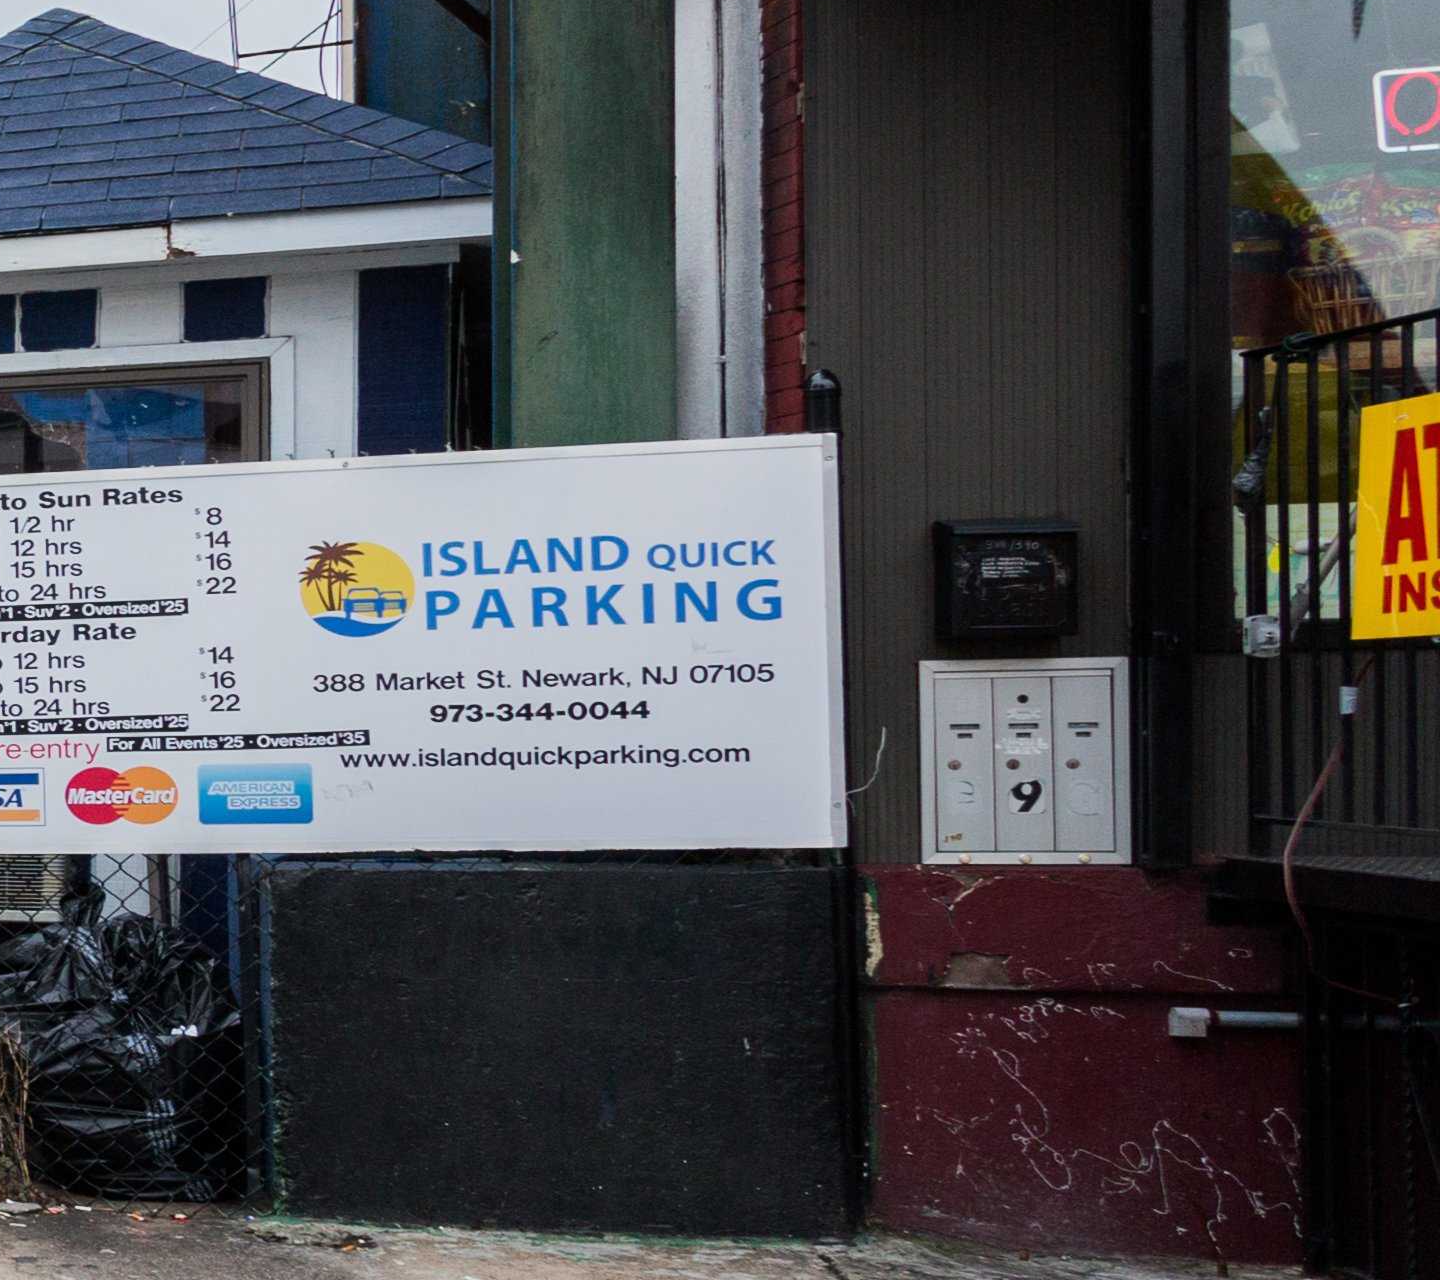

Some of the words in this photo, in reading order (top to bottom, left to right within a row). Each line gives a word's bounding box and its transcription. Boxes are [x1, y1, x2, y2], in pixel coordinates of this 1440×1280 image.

[0, 494, 26, 511] to
[39, 491, 91, 509] Sun
[103, 487, 183, 506] Rates
[10, 516, 41, 534] 1/2
[52, 515, 75, 532] hr
[10, 540, 35, 557] 12
[45, 538, 82, 555] hrs
[422, 536, 630, 577] ISLAND
[646, 539, 776, 572] QUICK
[10, 562, 35, 579] 15
[45, 560, 83, 577] hrs
[31, 583, 59, 600] 24
[69, 582, 106, 600] hrs
[425, 579, 782, 630] PARKING
[73, 622, 137, 641] Rate
[13, 652, 38, 671] 12
[47, 651, 85, 669] hrs
[14, 676, 39, 695] 15
[48, 675, 86, 694] hrs
[314, 674, 364, 693] 388
[376, 670, 465, 691] Market
[477, 669, 511, 689] St.
[522, 666, 631, 689] Newark,
[641, 665, 678, 686] NJ
[690, 663, 774, 684] 07105
[0, 699, 23, 718] to
[34, 699, 63, 717] 24
[72, 698, 110, 716] hrs
[430, 701, 650, 723] 973-344-0044
[108, 738, 134, 751] For
[141, 737, 160, 750] All
[339, 746, 751, 769] www.islandquickparking.com
[67, 786, 177, 807] MasterCard
[210, 782, 294, 795] AMERICAN
[1010, 779, 1043, 813] 9
[229, 796, 300, 808] EXPRESS
